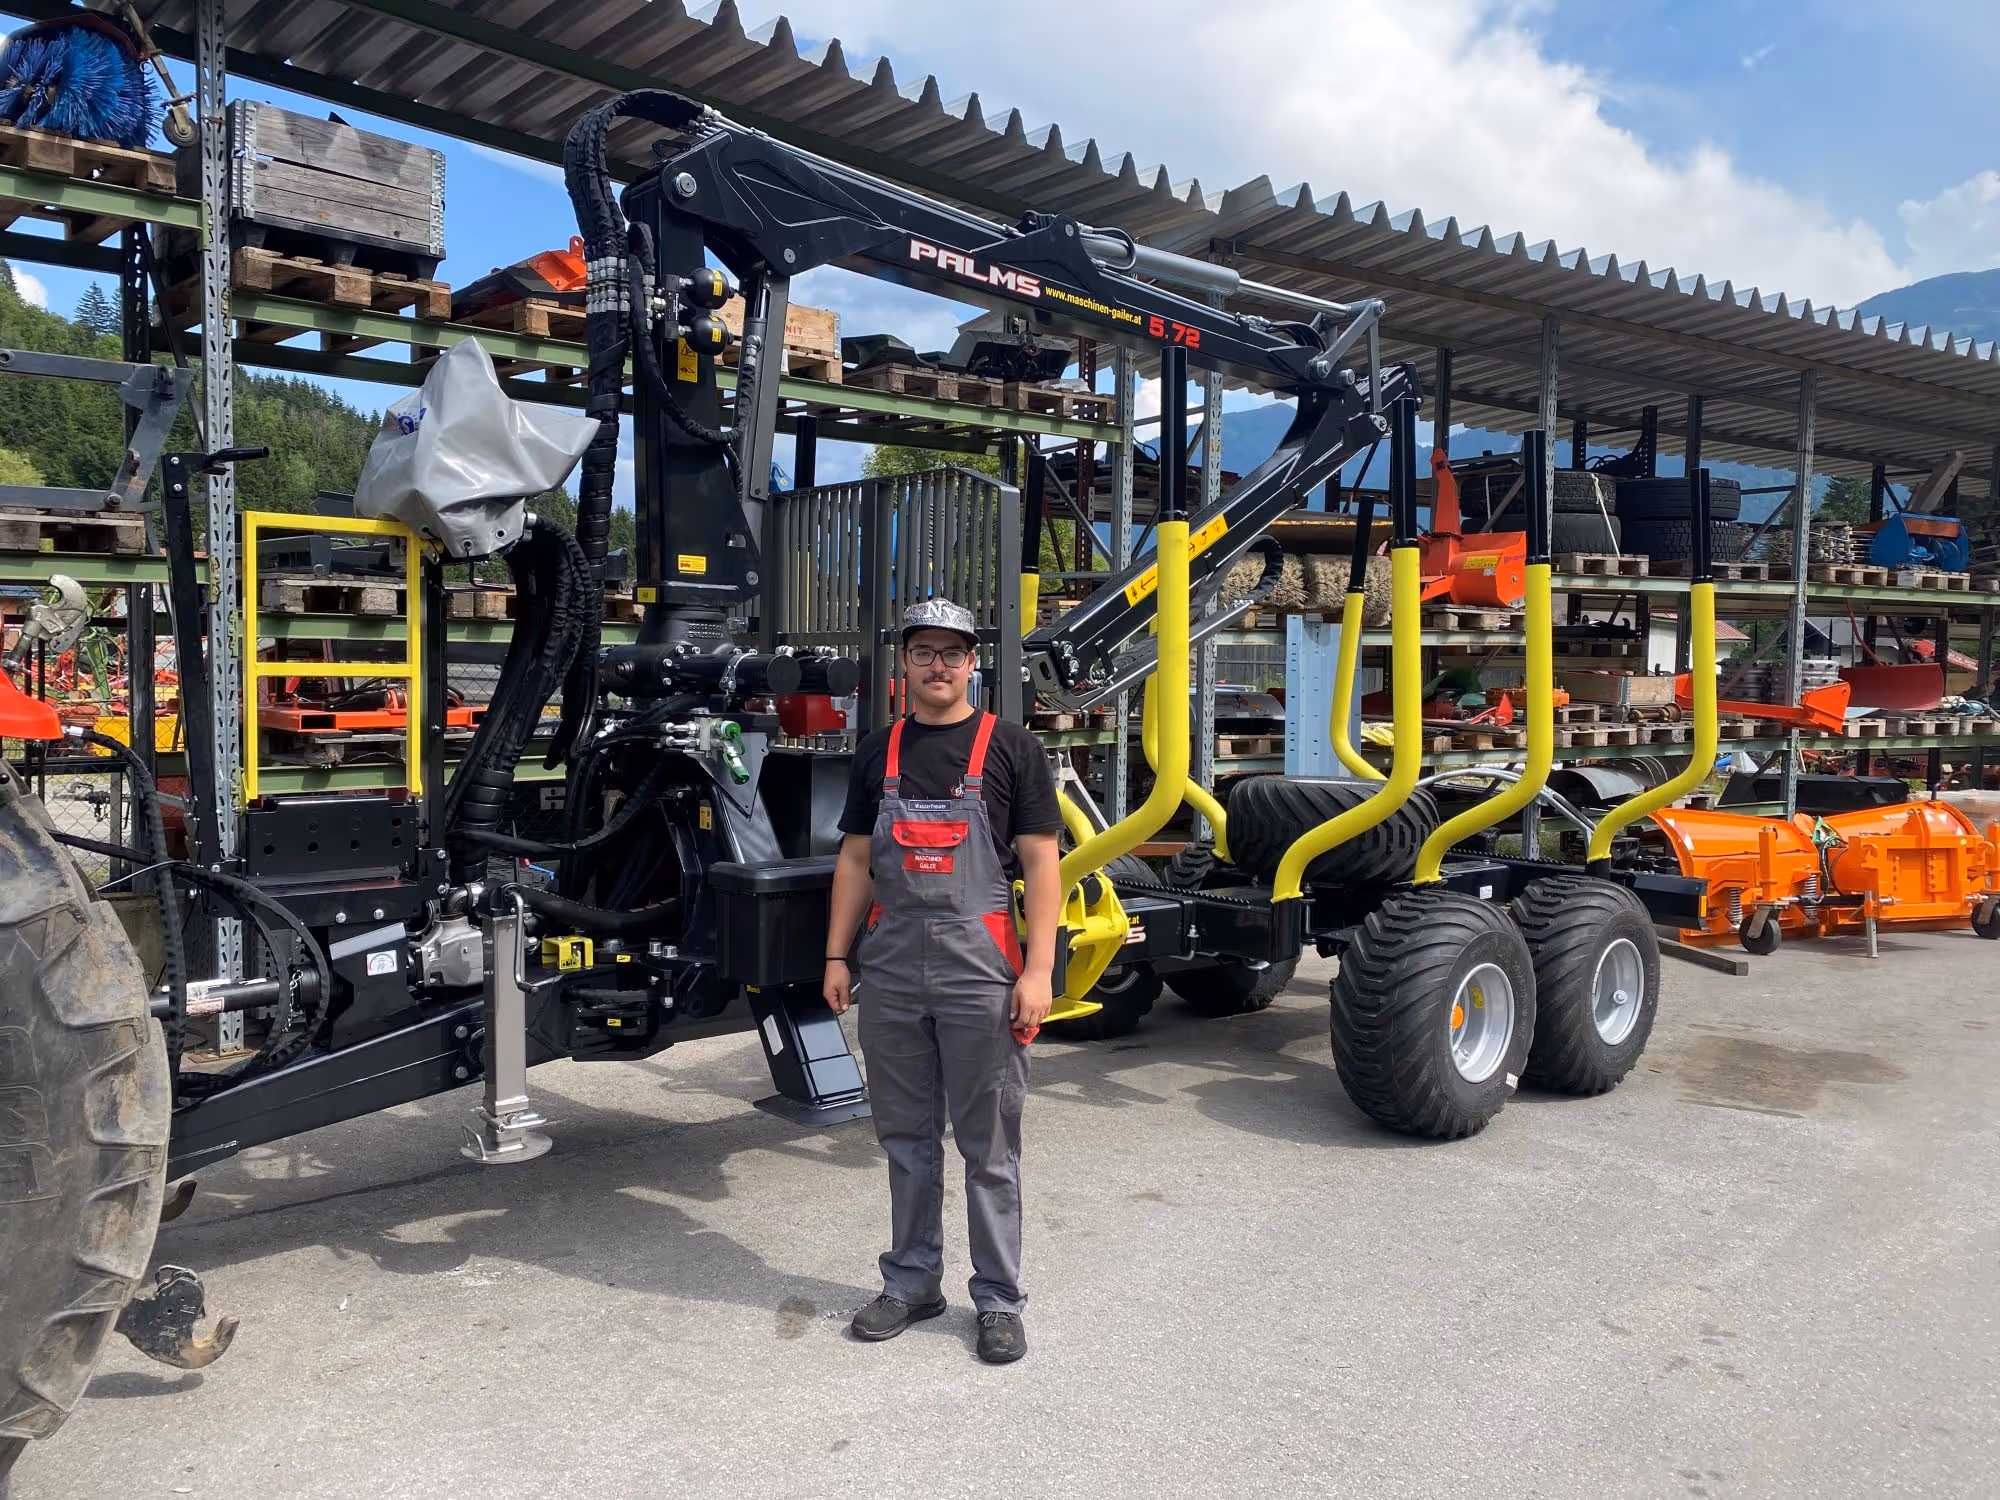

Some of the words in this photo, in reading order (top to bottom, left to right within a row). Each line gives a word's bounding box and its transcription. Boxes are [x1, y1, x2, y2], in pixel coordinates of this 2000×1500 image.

[909, 237, 1042, 299] PALMS
[1045, 286, 1142, 325] www.maschinen-gailer.at
[1148, 315, 1200, 349] 5.72
[923, 600, 960, 626] NY
